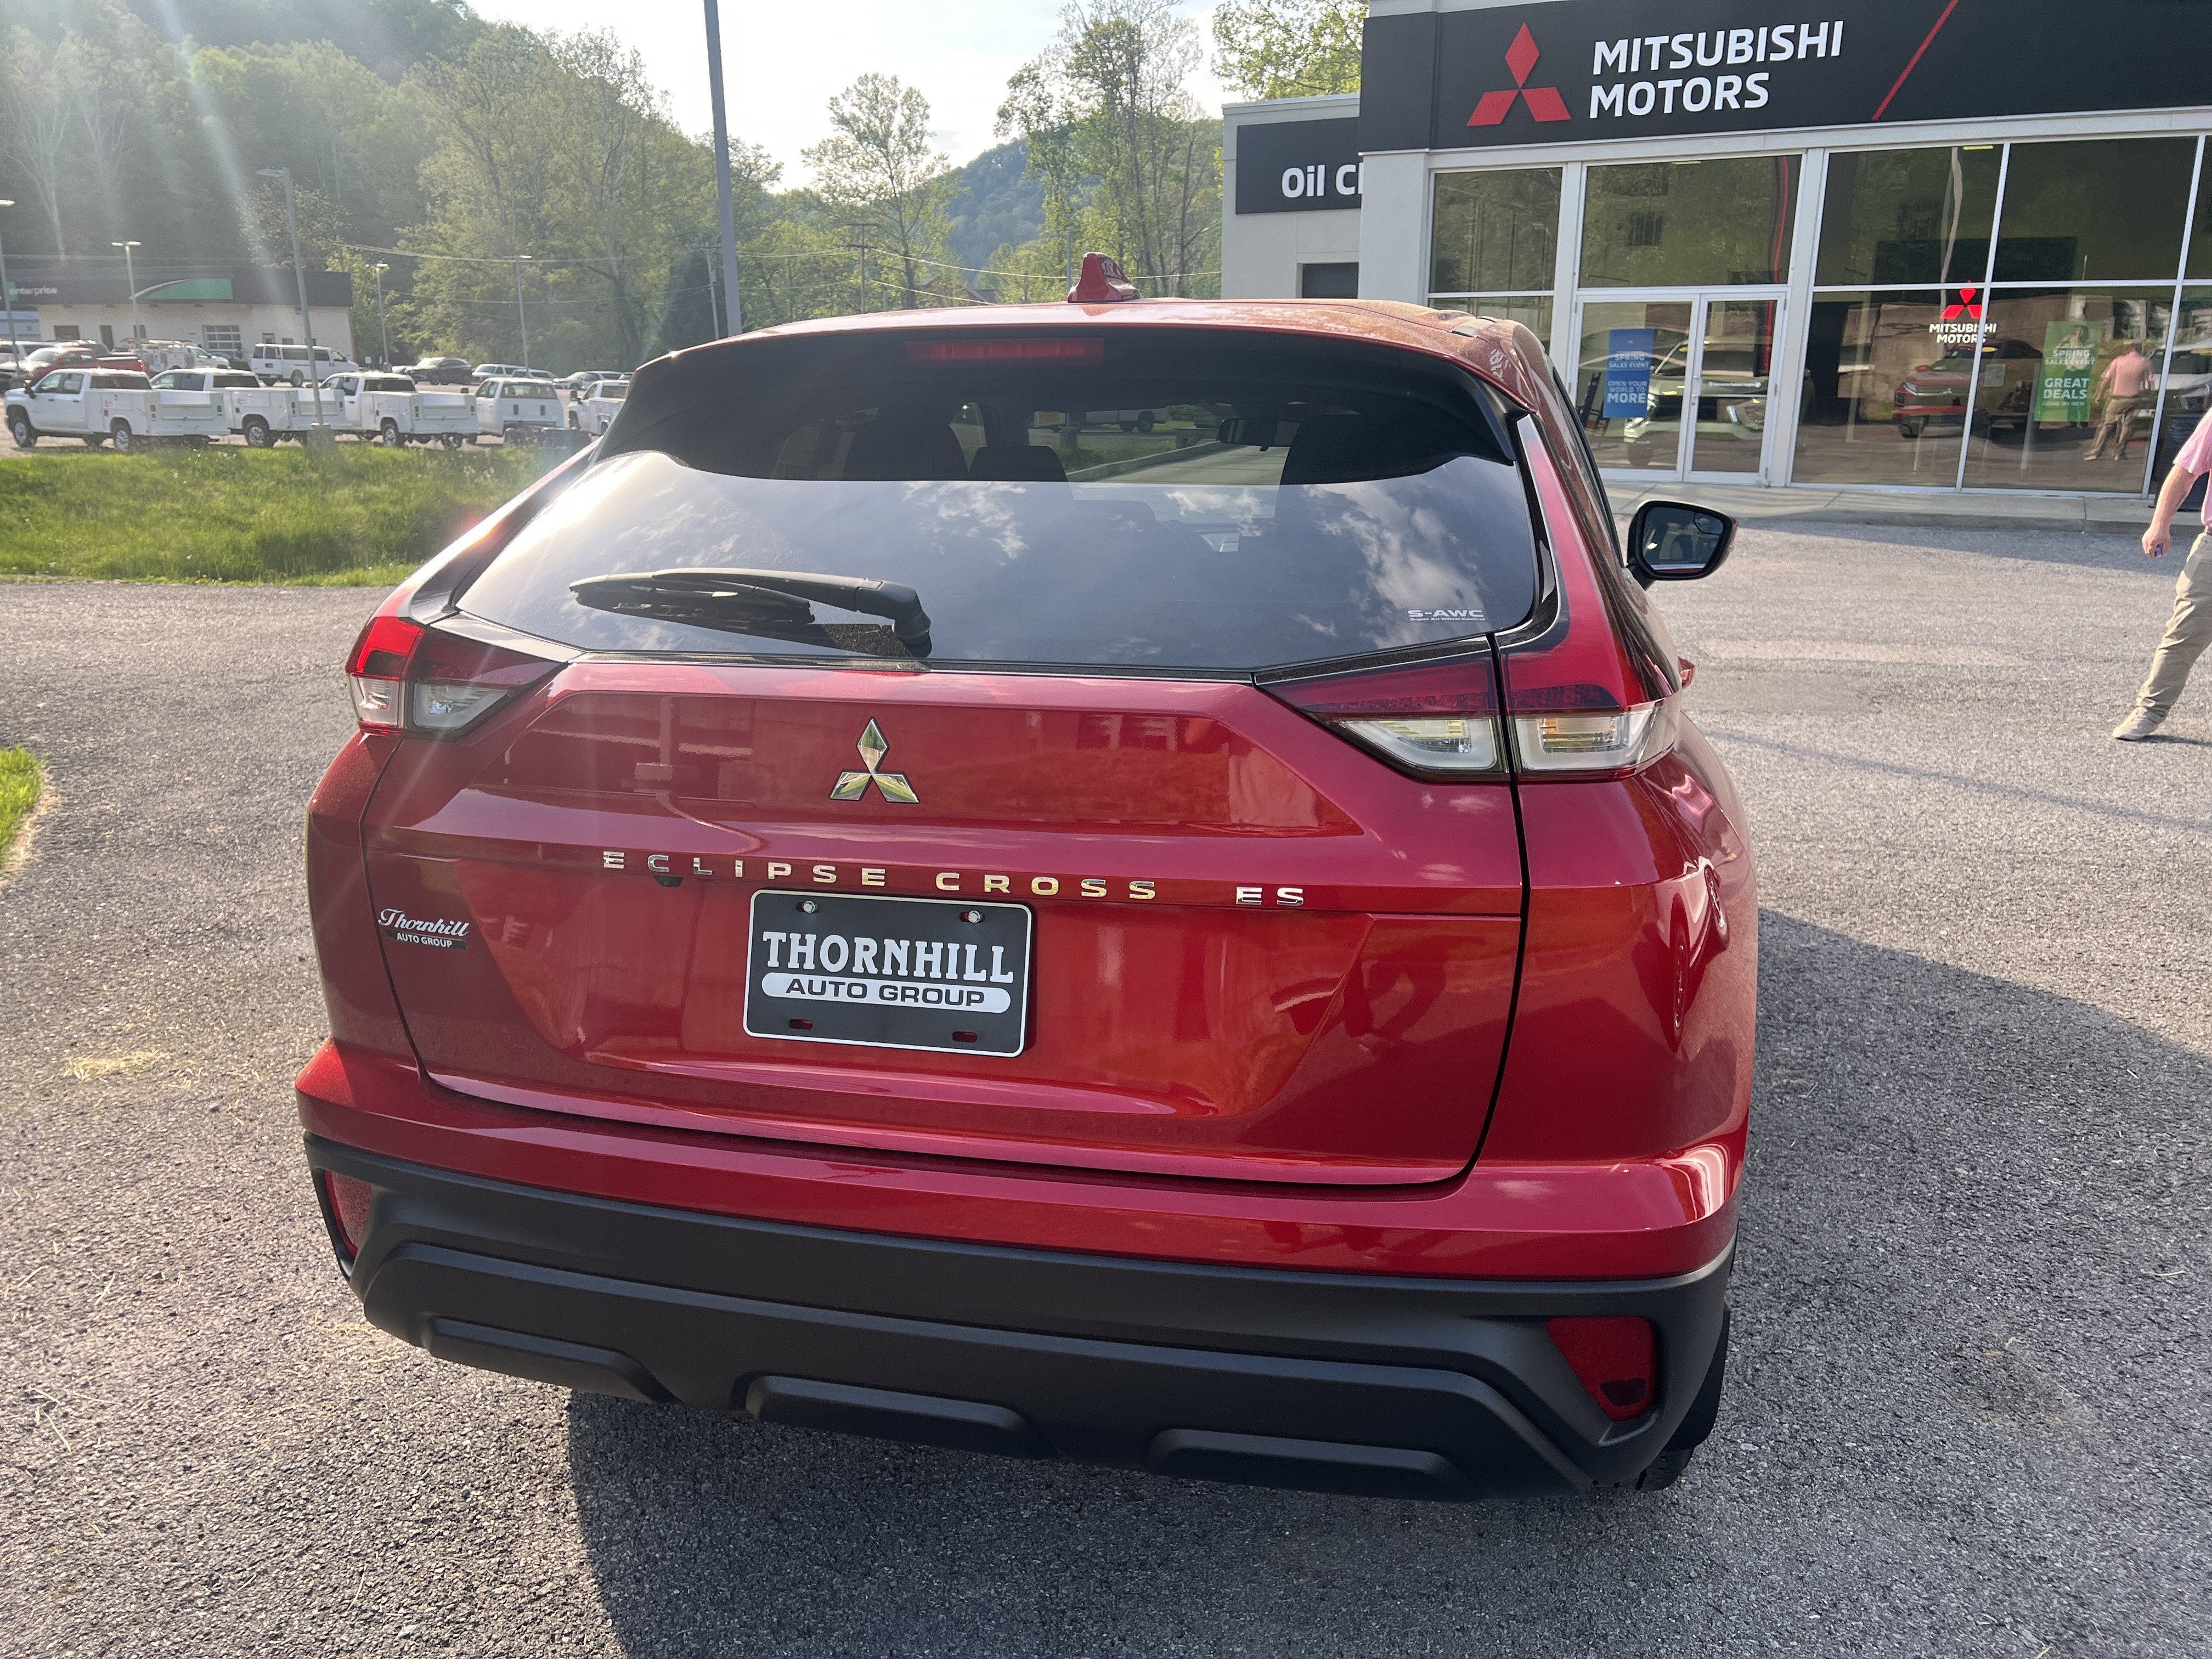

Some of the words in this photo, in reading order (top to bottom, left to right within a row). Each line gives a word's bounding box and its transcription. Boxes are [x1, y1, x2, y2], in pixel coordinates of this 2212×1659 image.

[1593, 20, 1844, 75] MITSUBISHI
[1589, 72, 1769, 119] MOTORS
[1282, 164, 1325, 198] Oil
[1929, 323, 1997, 333] MITSUBIHI
[2043, 389, 2087, 399] DEALS
[2044, 377, 2090, 388] GREAT
[1607, 392, 1646, 404] MORE
[603, 851, 886, 887] ECLIPSE
[935, 872, 1156, 900] CROSS
[1235, 886, 1304, 907] ES
[377, 908, 470, 937] Thornhill
[397, 932, 419, 944] AUTO
[421, 936, 453, 948] GROUP
[763, 931, 1014, 984] THORNHILL
[786, 978, 867, 1000] AUTO
[878, 984, 985, 1007] GROUP
